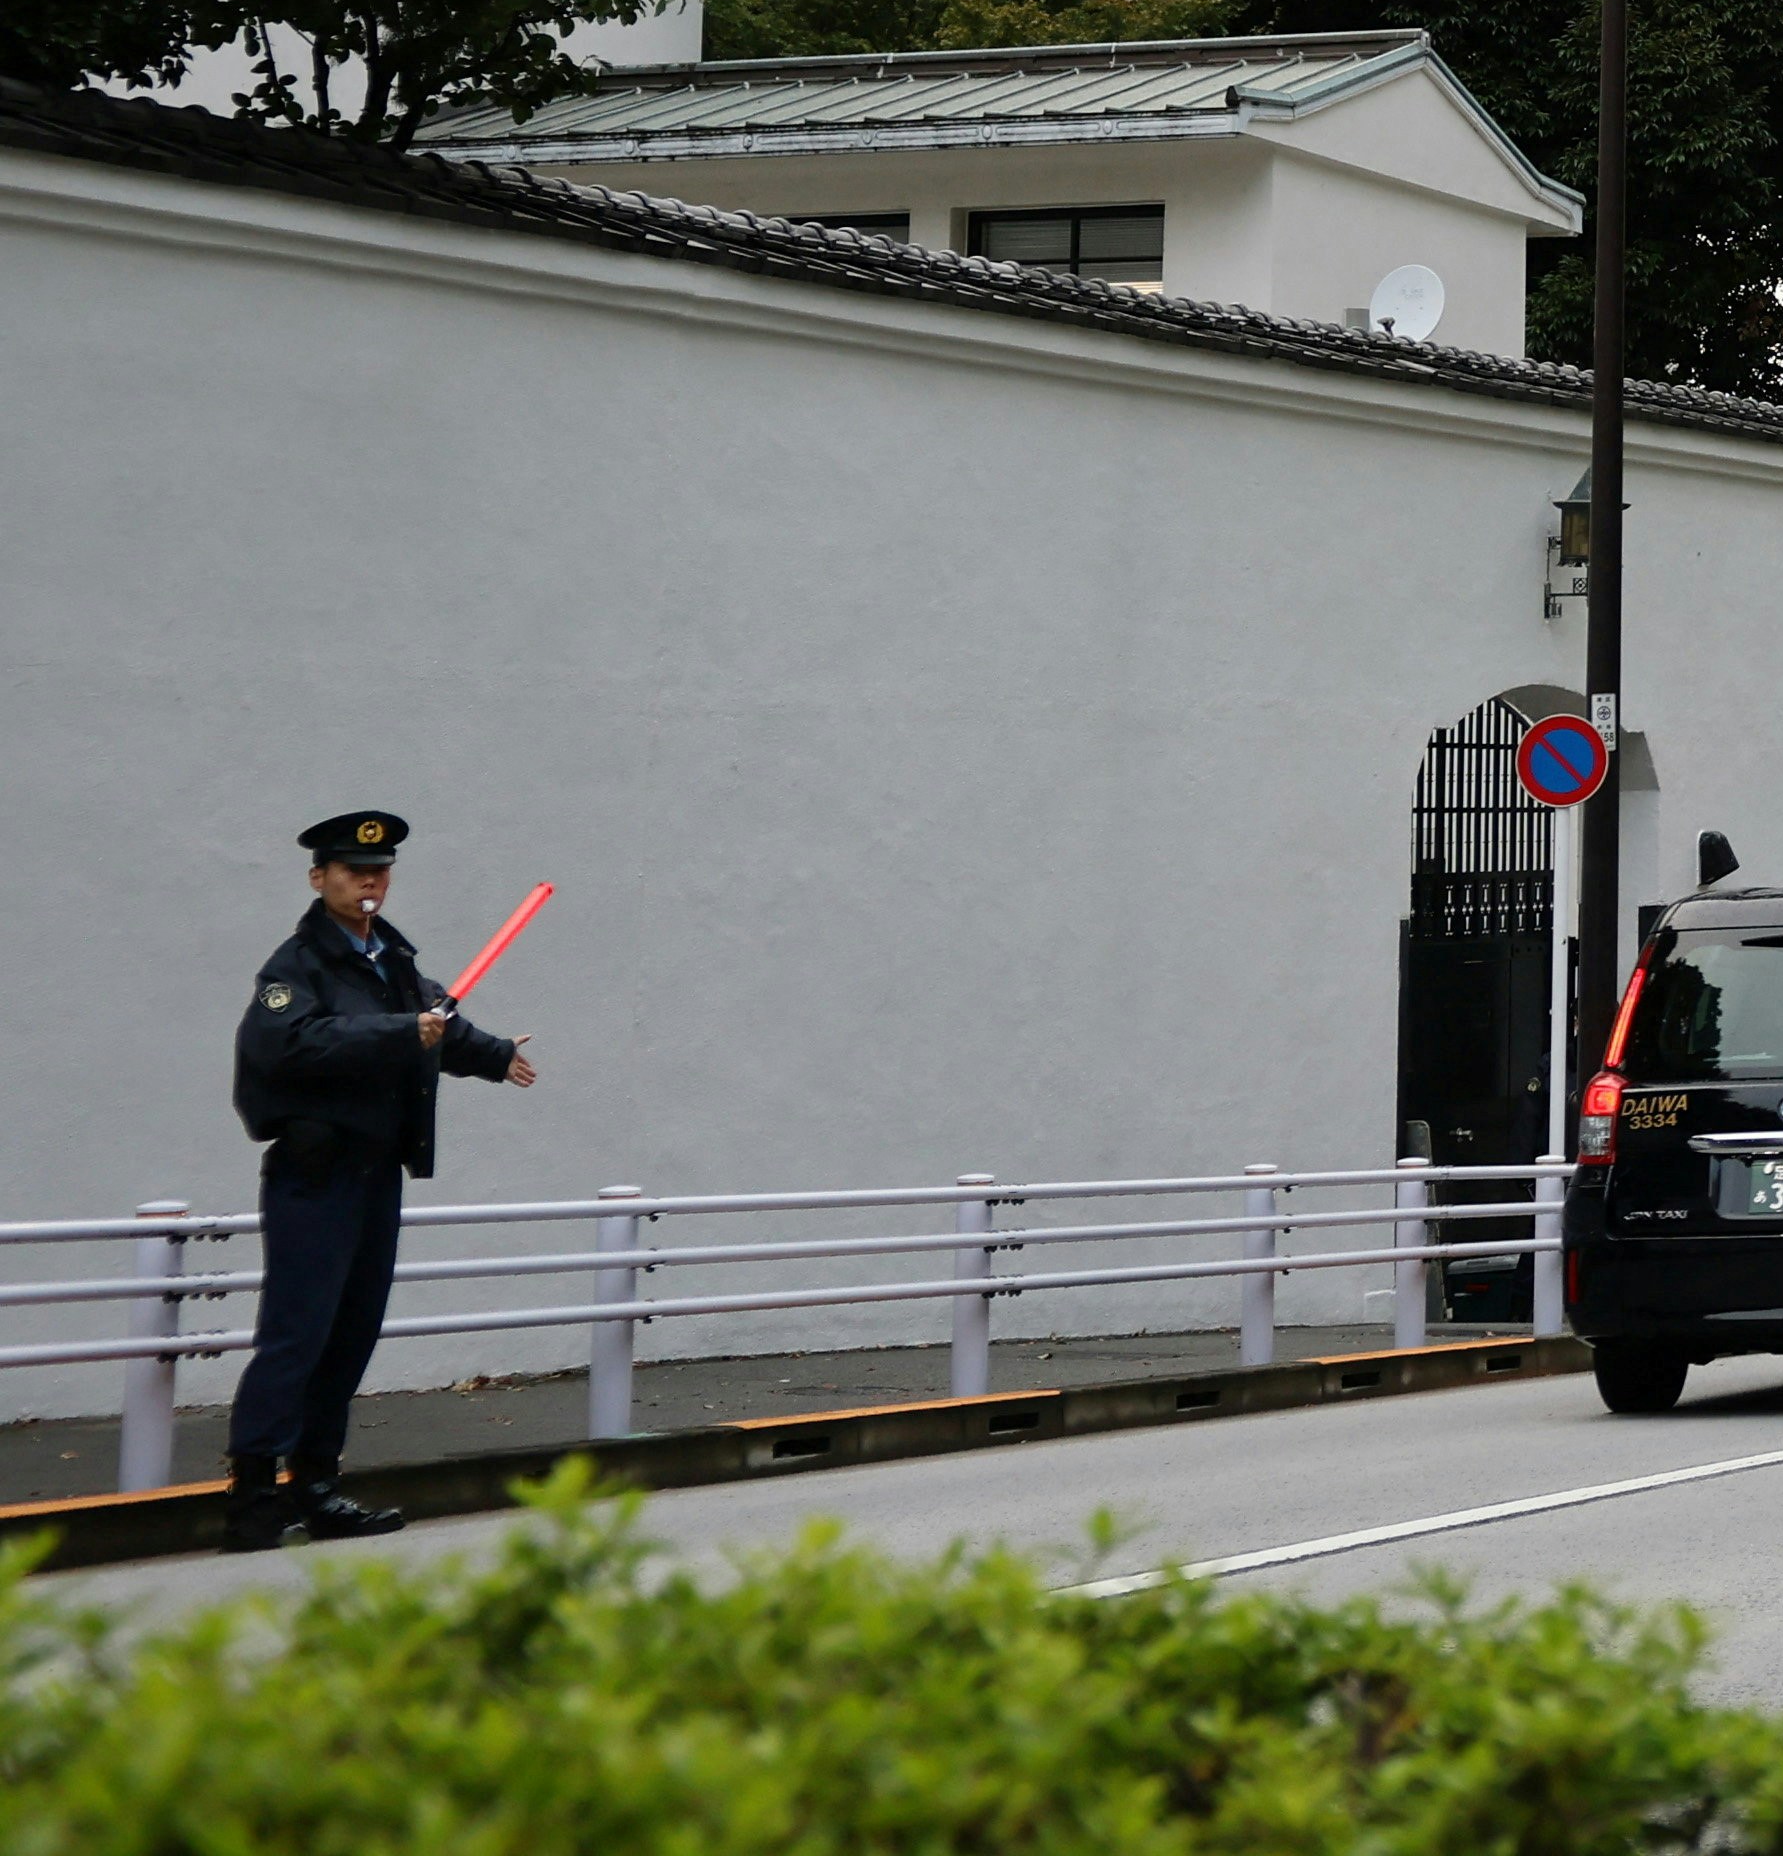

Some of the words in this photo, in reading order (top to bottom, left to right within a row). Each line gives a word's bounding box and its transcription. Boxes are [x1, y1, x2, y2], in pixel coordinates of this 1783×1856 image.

[1601, 732, 1615, 742] 58
[1621, 1094, 1688, 1116] DAIWA
[1629, 1113, 1678, 1130] 3334
[1753, 1190, 1767, 1204] あ
[1655, 1209, 1689, 1219] TAXI
